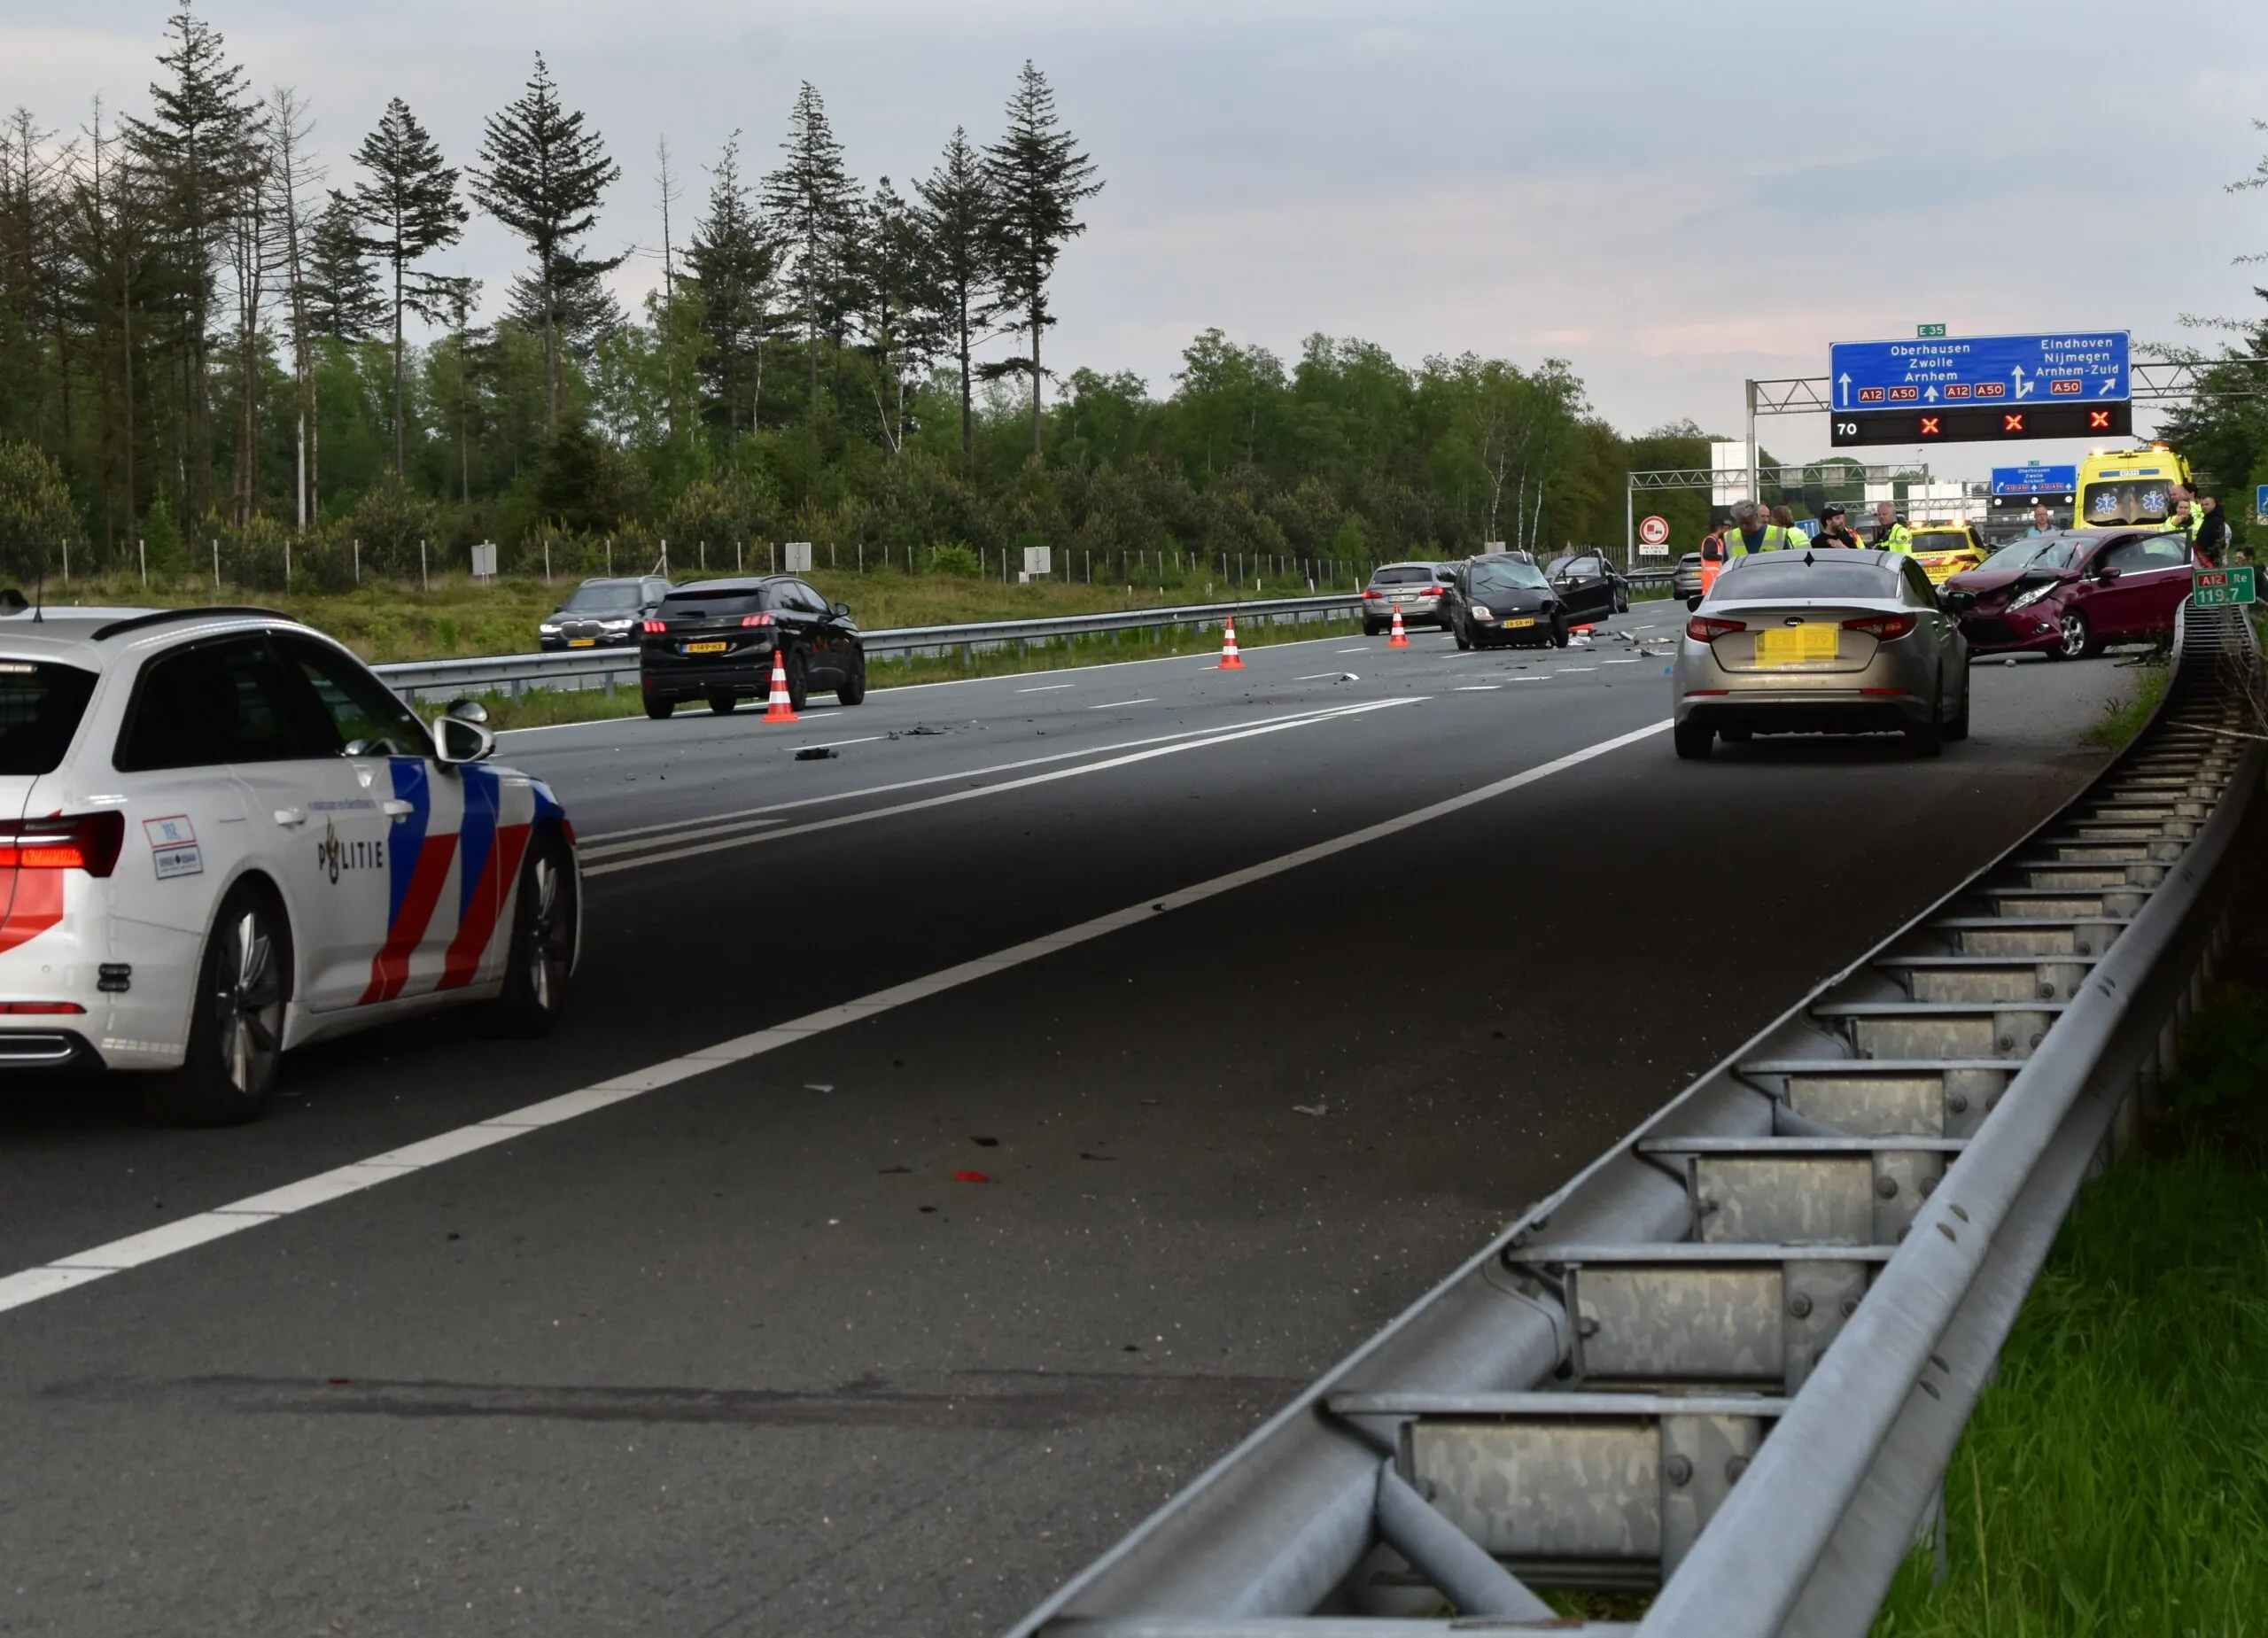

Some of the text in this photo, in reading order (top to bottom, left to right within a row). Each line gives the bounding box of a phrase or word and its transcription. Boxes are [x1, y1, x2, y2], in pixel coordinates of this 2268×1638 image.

[1919, 326, 1944, 336] E 35
[2041, 338, 2113, 350] Eindhoven
[1891, 345, 1970, 356] Oberhausen
[1909, 357, 1953, 369] Zwolle
[2045, 353, 2109, 366] Nijmegen
[2036, 364, 2119, 377] Arnhem-Zuid
[1905, 372, 1958, 383] Arnhem
[1947, 385, 2002, 396] A12 A50
[2054, 383, 2079, 392] A50
[1861, 389, 1916, 400] A12 A50
[1837, 423, 1858, 435] 70
[2202, 573, 2248, 586] A12 Re
[2198, 587, 2240, 602] 119.7
